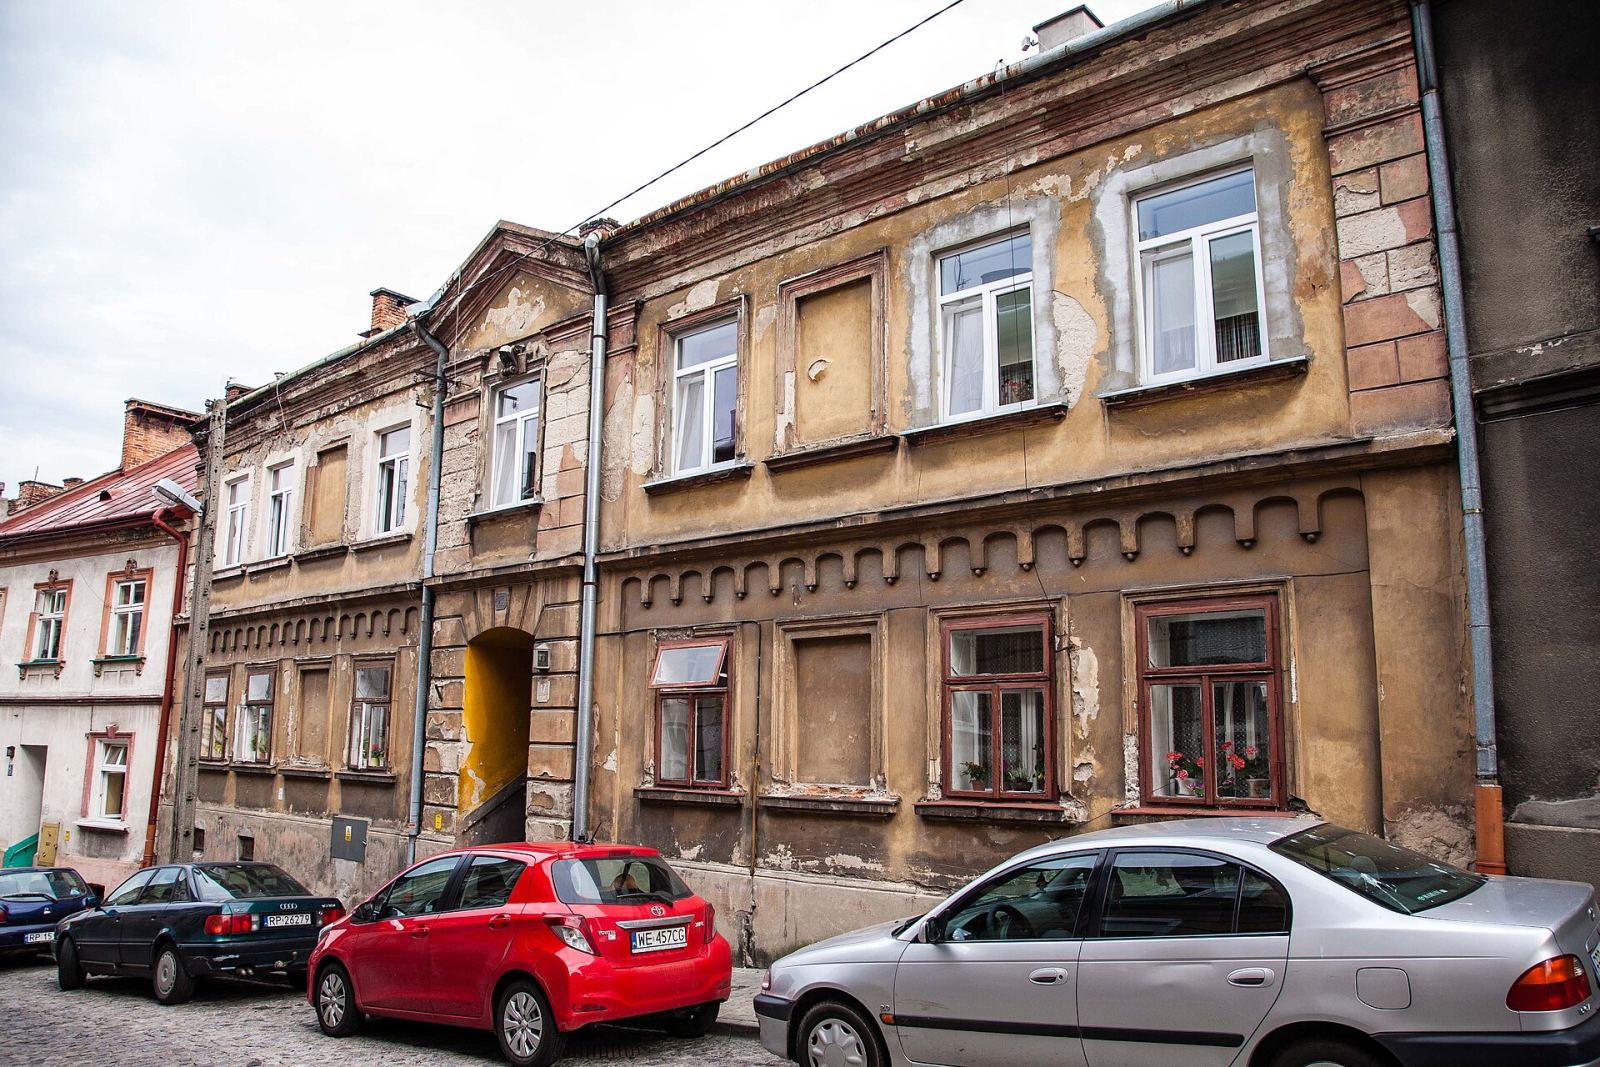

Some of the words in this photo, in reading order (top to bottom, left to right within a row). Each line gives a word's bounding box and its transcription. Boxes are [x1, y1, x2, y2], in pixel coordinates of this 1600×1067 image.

[269, 917, 281, 926] RP
[285, 914, 310, 925] 26279
[30, 933, 41, 942] RP
[44, 932, 53, 940] 15
[638, 932, 653, 946] WE
[656, 928, 685, 944] 457CG
